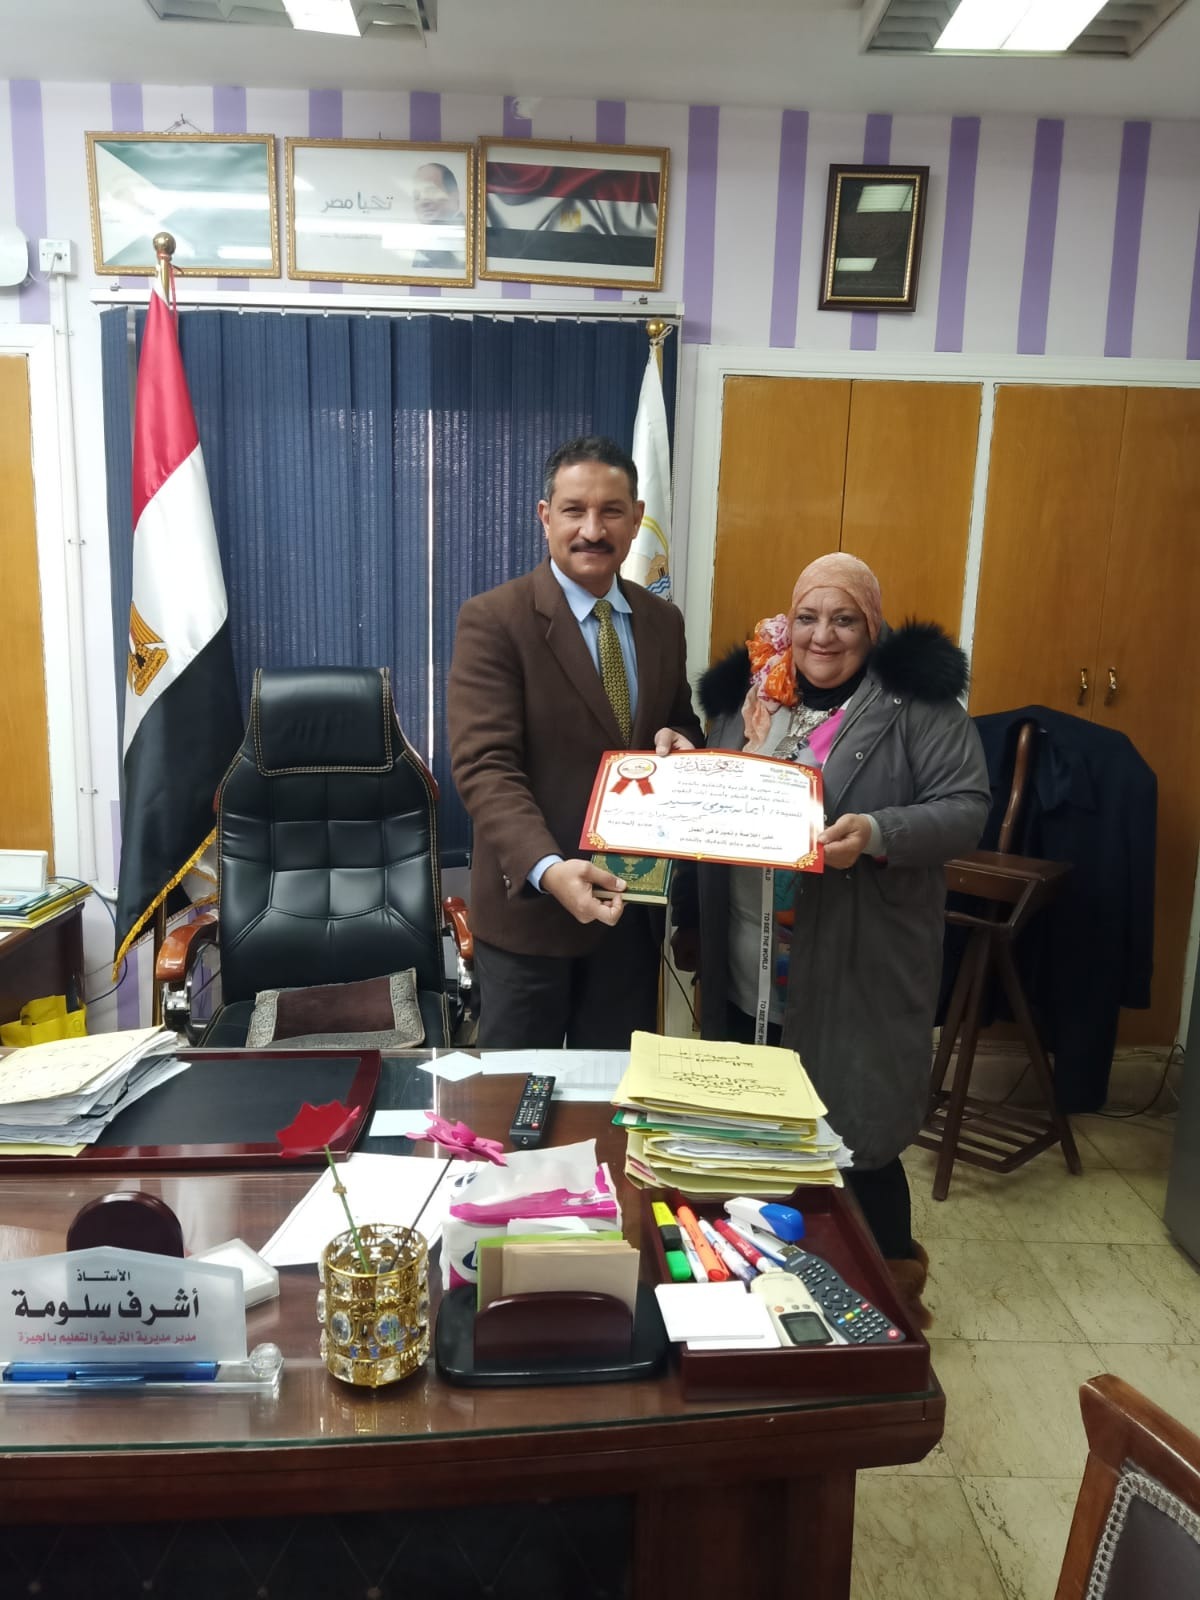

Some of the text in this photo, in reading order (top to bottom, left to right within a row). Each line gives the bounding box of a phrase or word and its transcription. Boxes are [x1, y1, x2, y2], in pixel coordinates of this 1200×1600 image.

[320, 191, 394, 214] تحيا مصر
[763, 912, 771, 921] TO
[762, 935, 770, 947] THE
[761, 947, 769, 970] WORLD
[760, 1000, 767, 1009] TO
[758, 1009, 766, 1022] SEE
[757, 1022, 765, 1034] THE
[77, 1269, 131, 1282] الأستاذ
[11, 1287, 200, 1326] أشرف سلومة
[17, 1331, 197, 1345] مدير مديرية التربية والتعليم بالجيزة
